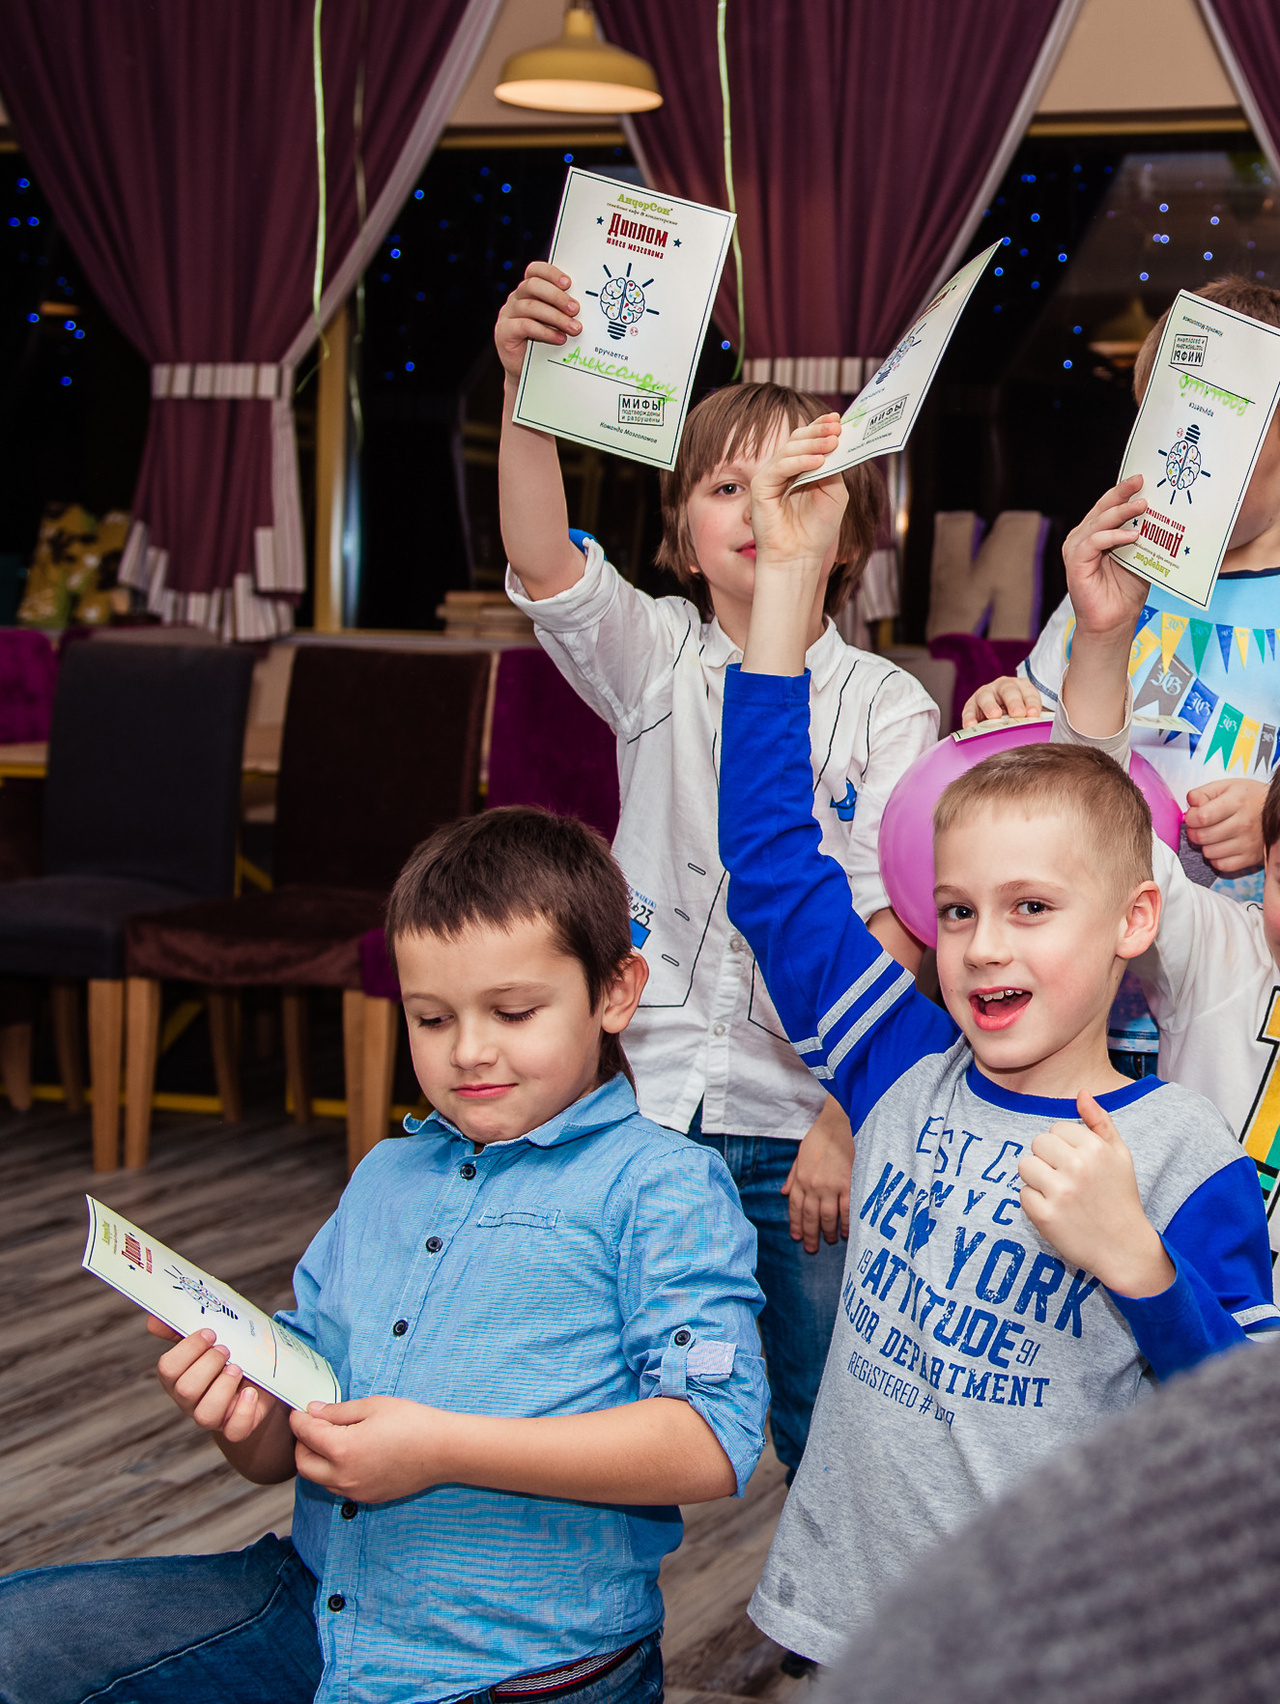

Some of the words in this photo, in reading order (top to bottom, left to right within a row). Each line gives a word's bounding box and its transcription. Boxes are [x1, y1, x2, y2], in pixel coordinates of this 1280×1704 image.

[594, 346, 629, 362] вручается
[1173, 349, 1203, 363] МИФЫ
[621, 397, 661, 412] МИФЫ
[945, 1225, 1100, 1339] YORK
[846, 1350, 920, 1409] REGISTERED
[879, 1326, 1050, 1408] DEPARTMENT
